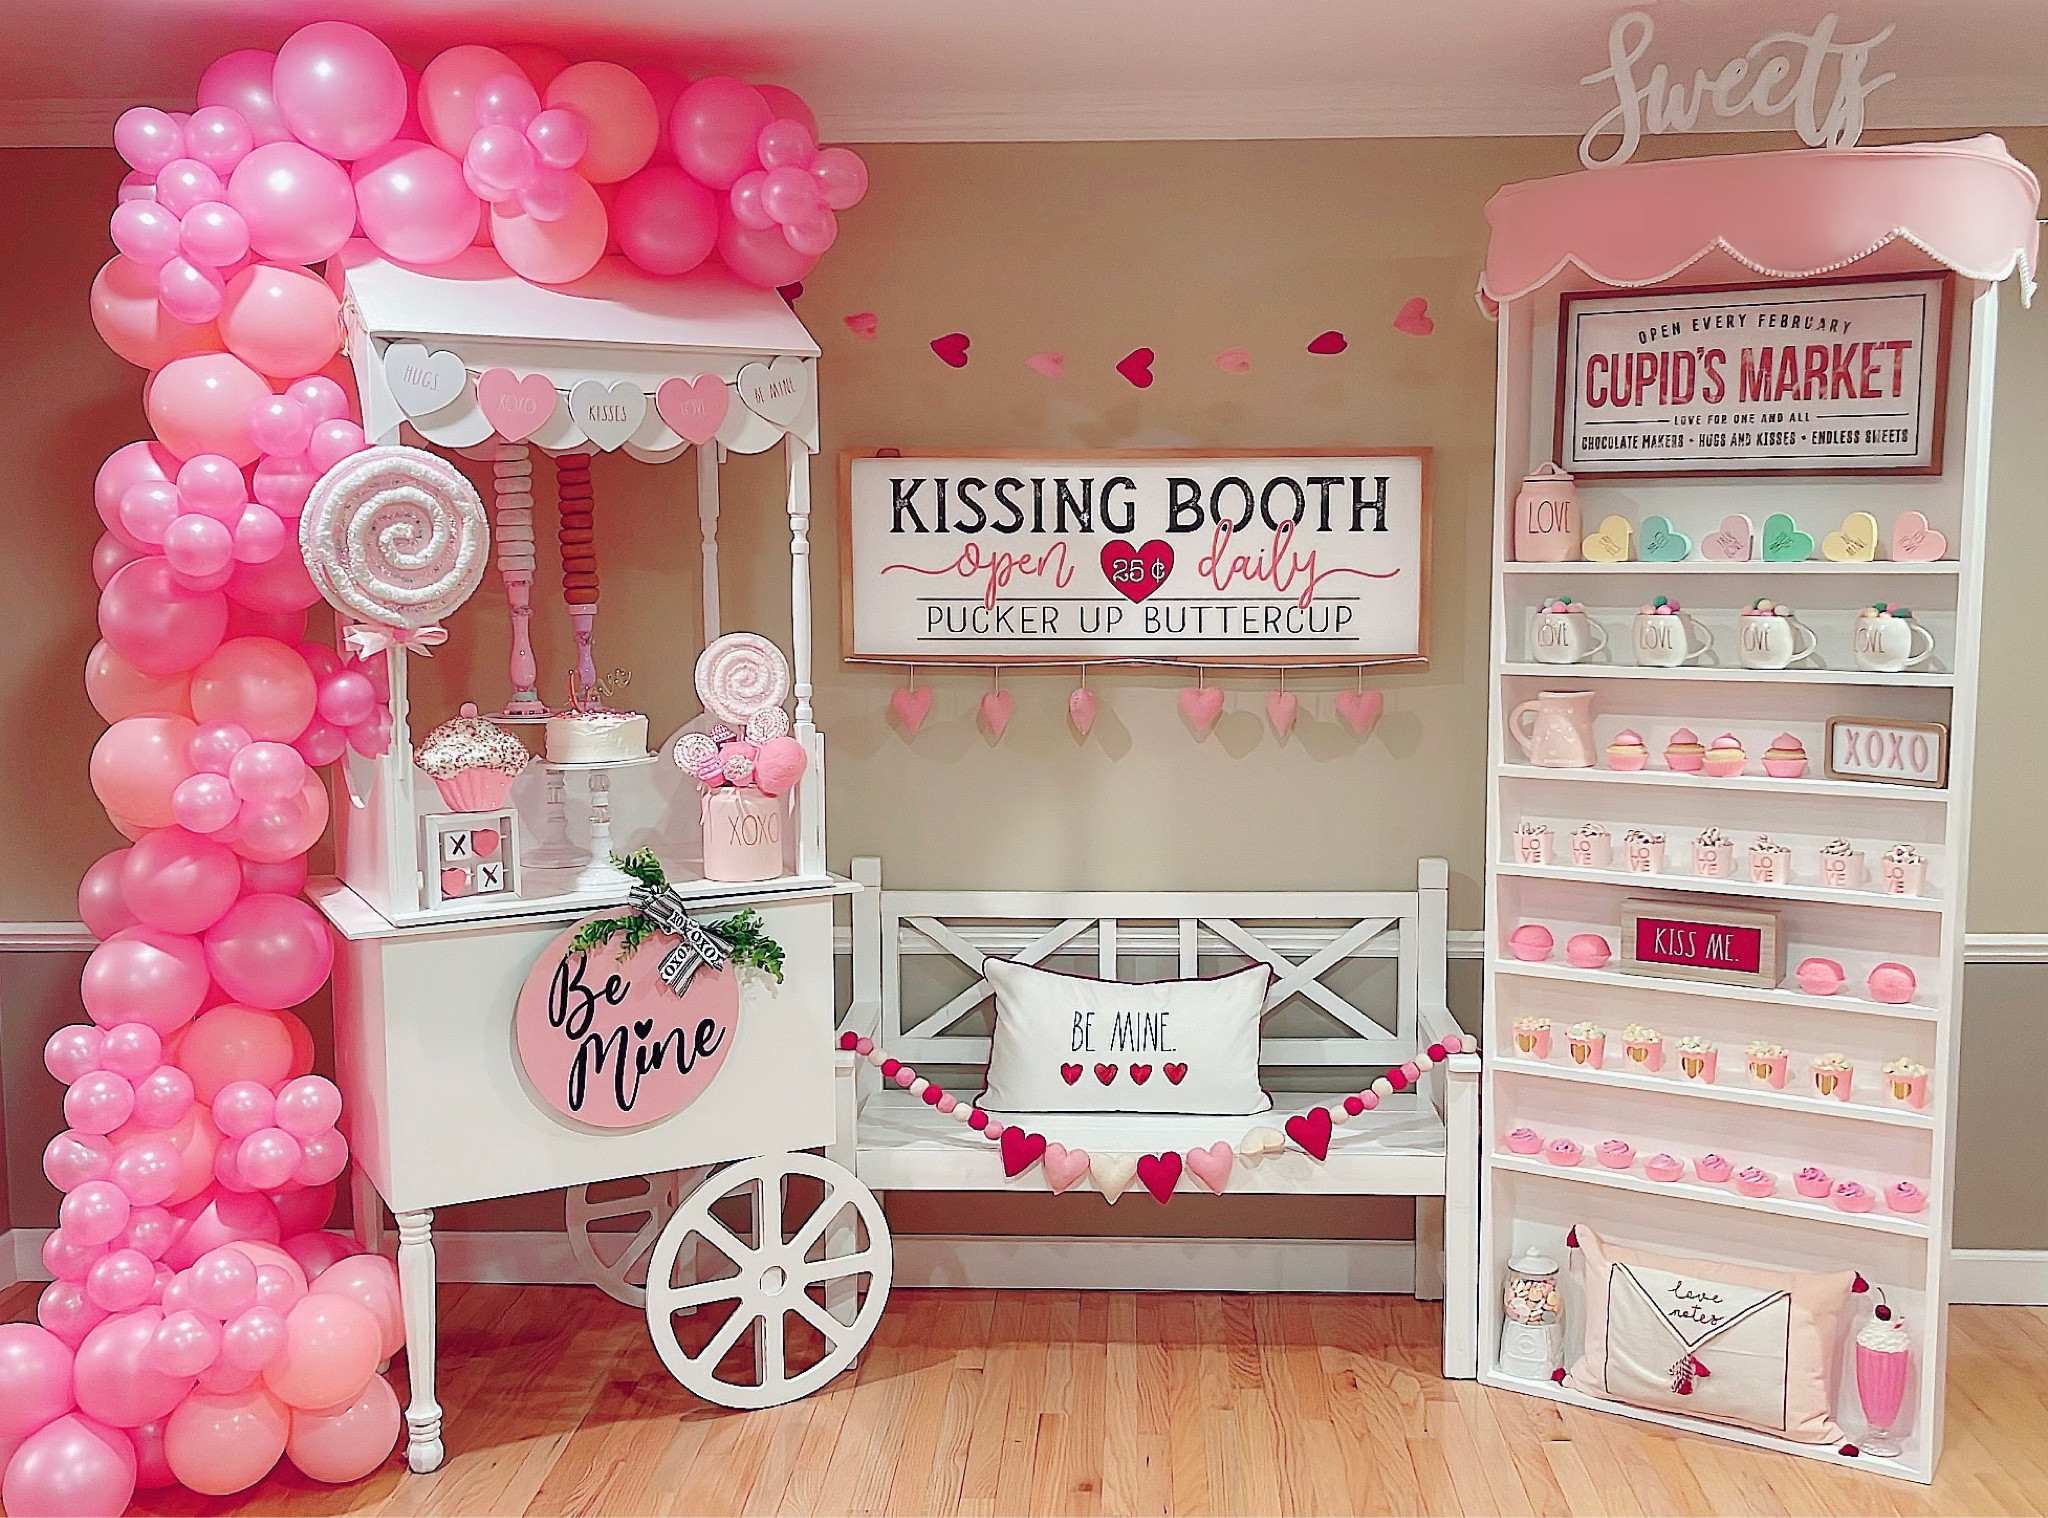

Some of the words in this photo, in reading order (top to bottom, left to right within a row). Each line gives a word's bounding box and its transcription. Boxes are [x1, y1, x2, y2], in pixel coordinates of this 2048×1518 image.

[1579, 12, 1896, 170] Sweets
[1638, 322, 1681, 344] OPEN
[1692, 313, 1747, 332] EVERY
[1758, 313, 1852, 334] FEBRUARY
[403, 365, 440, 391] HUGS
[1586, 347, 1727, 408] CUPID'S
[1738, 340, 1912, 403] MARKET
[500, 393, 537, 415] XOXO
[754, 388, 765, 404] BE
[769, 376, 796, 400] MINE
[588, 404, 627, 422] KISSES
[1673, 415, 1702, 426] LOVE
[1707, 414, 1727, 425] FOR
[1733, 413, 1756, 424] ONE
[1761, 412, 1784, 424] AND
[1789, 412, 1811, 423] ALL
[1581, 435, 1638, 451] CHOCOLATE
[1641, 434, 1684, 450] MAKERS
[1698, 433, 1726, 448] HUGS
[1730, 432, 1751, 447] AND
[1756, 431, 1796, 446] KISSES
[1811, 430, 1861, 445] ENDLESS
[1865, 429, 1909, 444] SWEETS
[889, 476, 1137, 534] KISSING
[1166, 476, 1391, 534] BOOTH
[1528, 500, 1571, 534] LOVE
[881, 541, 1074, 610] open
[1112, 558, 1145, 581] 25
[1198, 519, 1400, 608] daily
[927, 605, 1060, 634] PUCKER
[1080, 605, 1124, 634] UP
[1145, 605, 1354, 634] BUTTERCUP
[1537, 622, 1569, 647] LOVE
[1639, 624, 1673, 650] LOVE
[1843, 728, 1928, 773] XOXO
[728, 812, 779, 846] XOXO
[1521, 837, 1541, 850] LO
[1572, 840, 1591, 852] LO
[1630, 846, 1650, 859] LO
[1825, 859, 1845, 872] LO
[1654, 927, 1697, 958] KISS
[1705, 933, 1739, 962] ME.
[548, 948, 631, 1041] Be
[1071, 1010, 1096, 1052] BE
[1110, 1010, 1177, 1052] MINE.
[567, 1016, 727, 1112] Mine
[1667, 1280, 1723, 1304] love
[1668, 1304, 1724, 1326] notes
